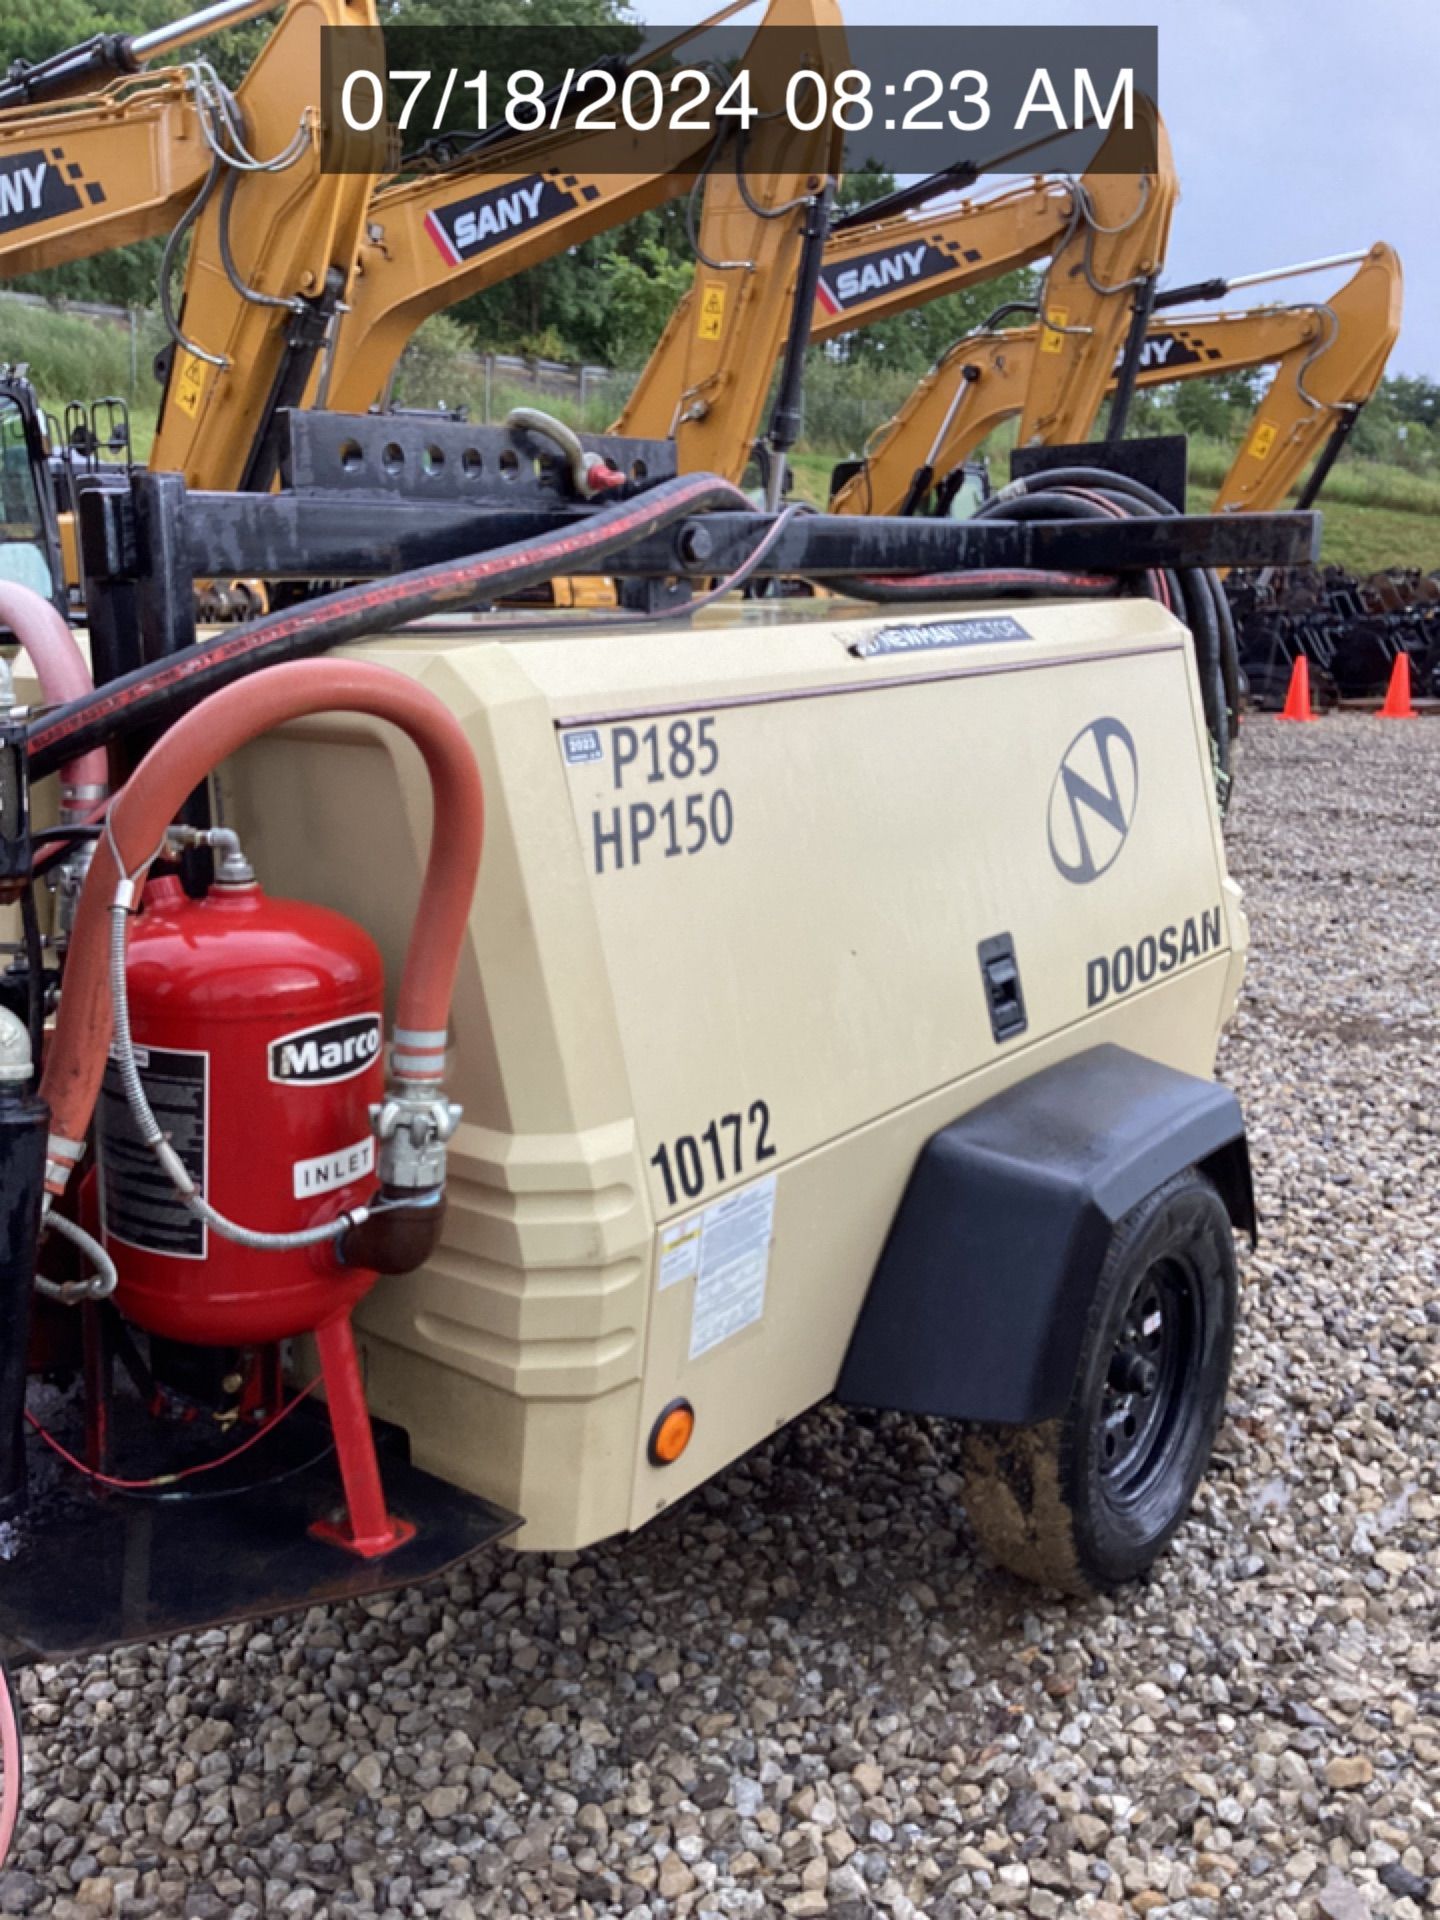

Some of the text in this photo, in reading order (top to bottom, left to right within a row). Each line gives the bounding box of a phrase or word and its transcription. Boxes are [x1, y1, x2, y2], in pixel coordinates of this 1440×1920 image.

[453, 181, 545, 249] SANY
[836, 245, 927, 300] SANY
[611, 716, 719, 789] P185
[592, 788, 733, 874] HP150
[1087, 905, 1221, 1008] DOOSAN
[279, 1027, 379, 1076] Marco
[303, 1147, 369, 1188] INLET
[650, 1098, 777, 1205] 10172
